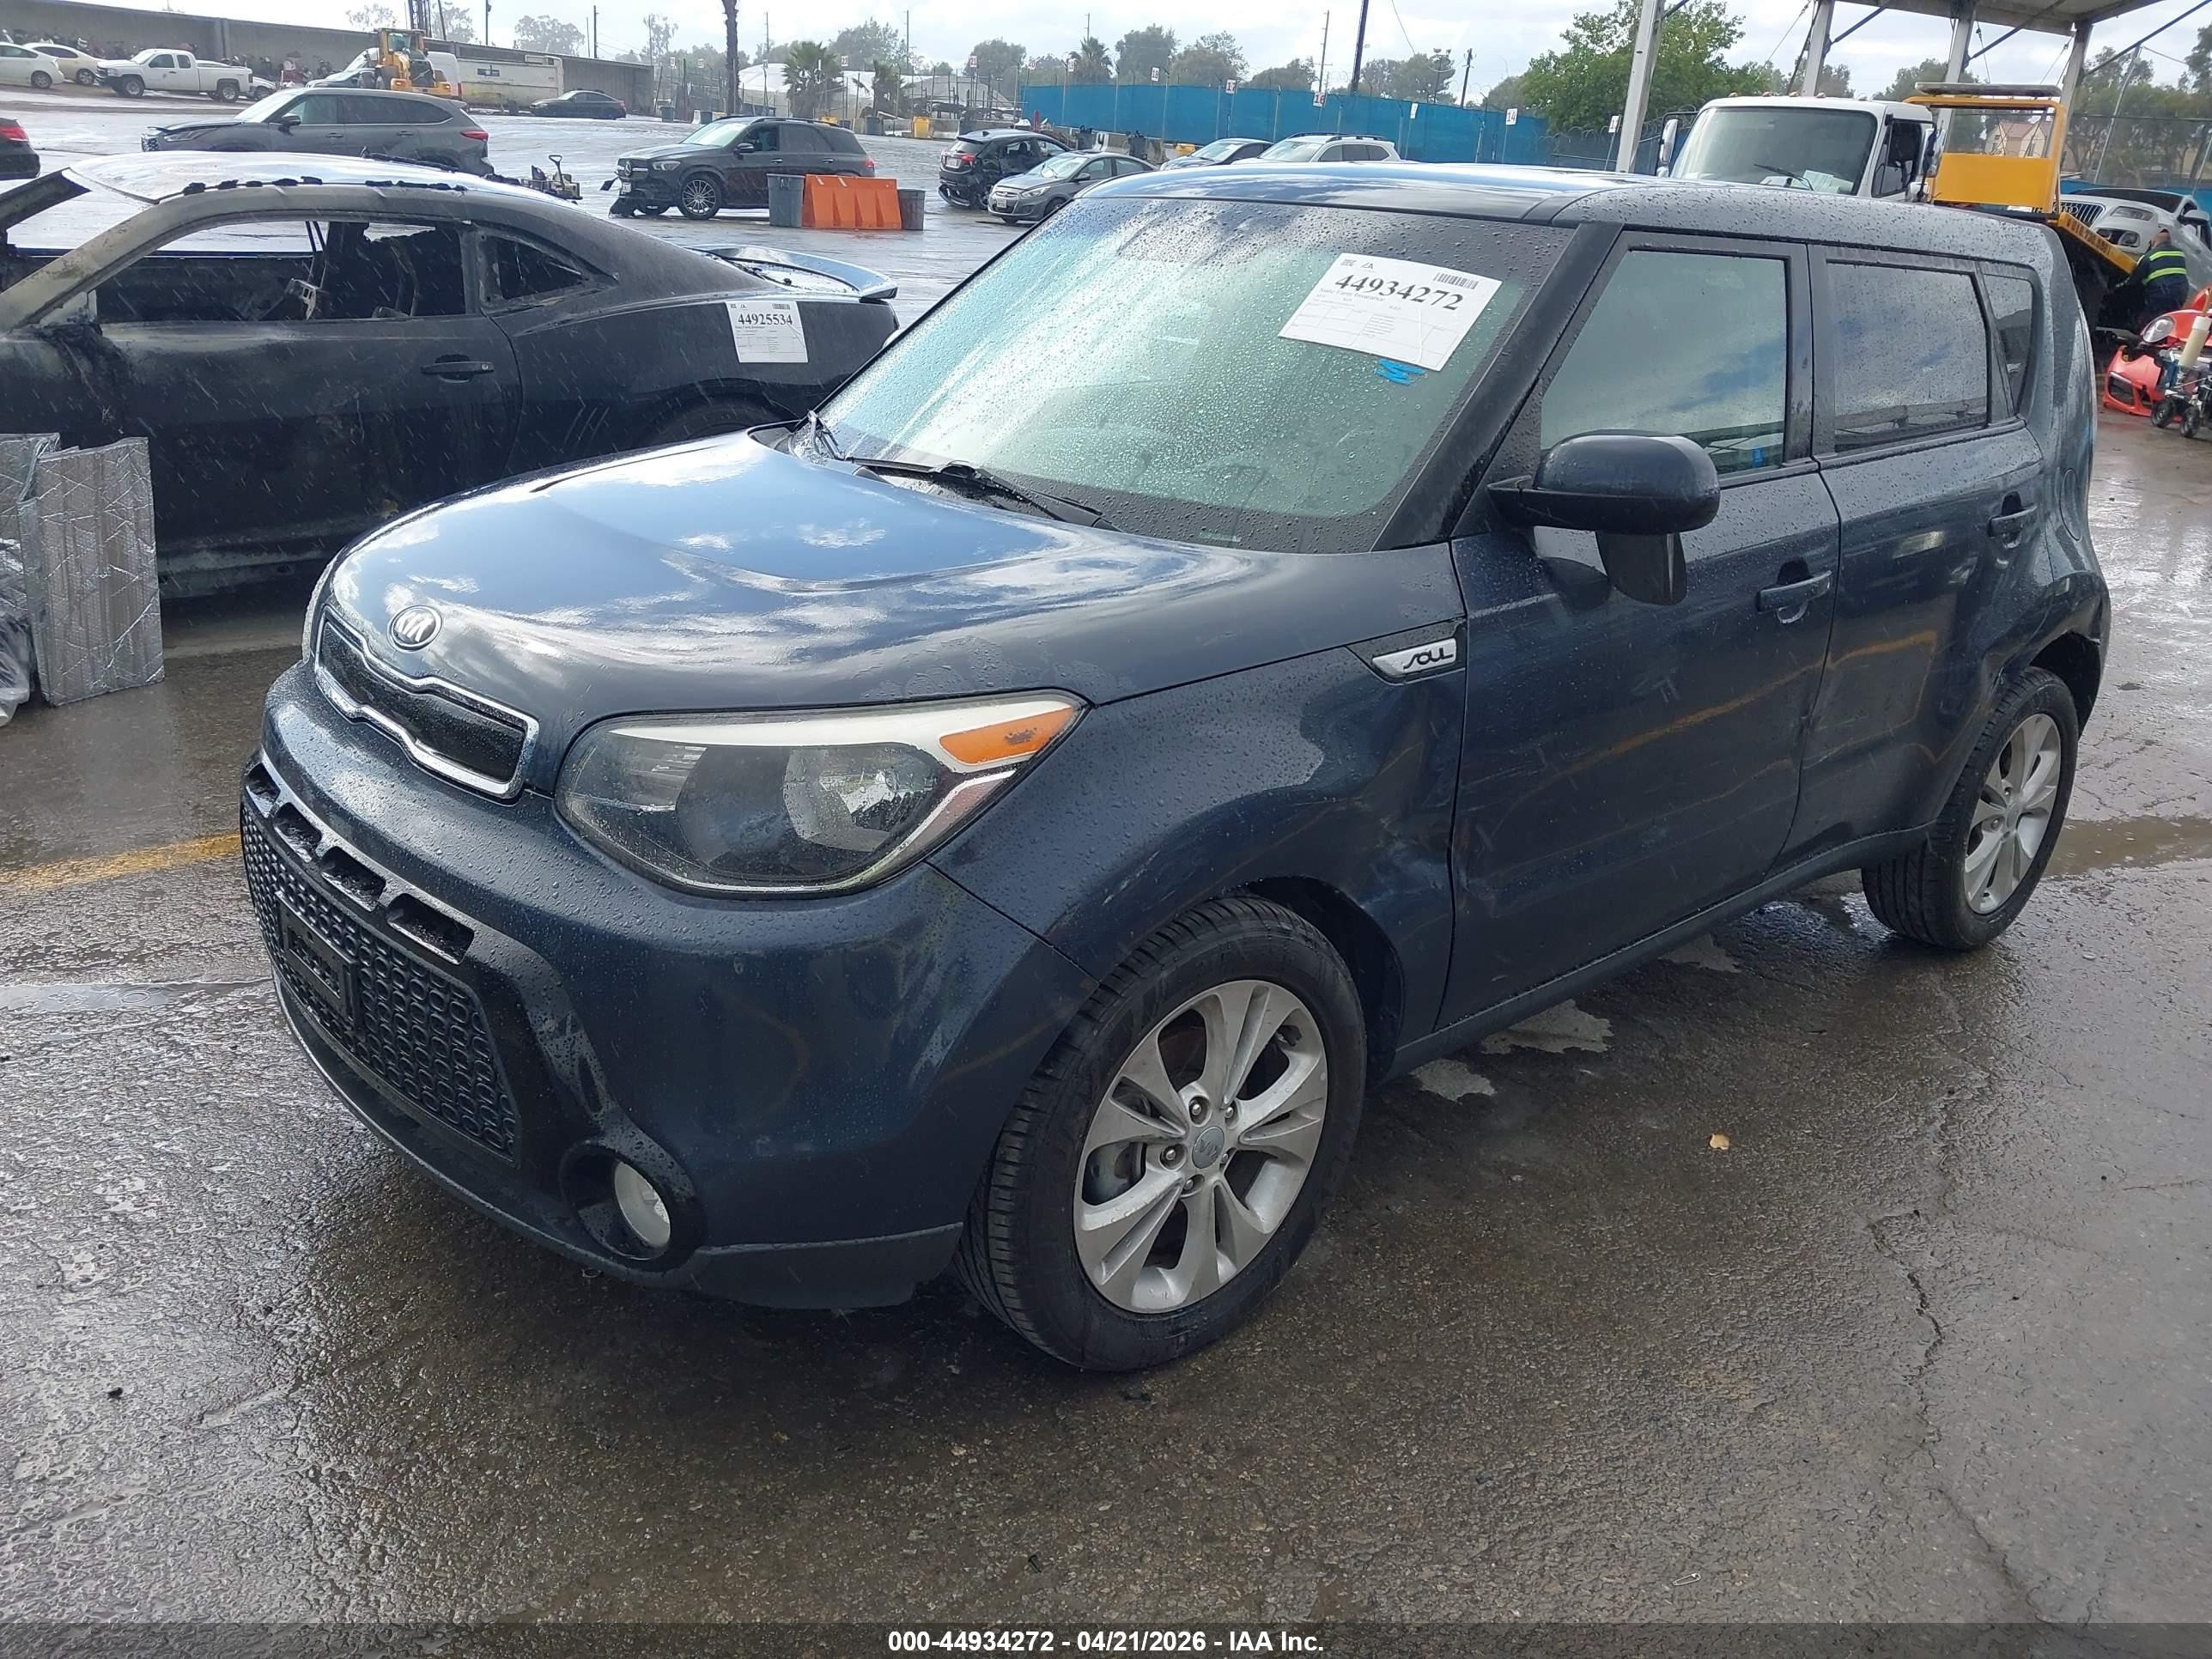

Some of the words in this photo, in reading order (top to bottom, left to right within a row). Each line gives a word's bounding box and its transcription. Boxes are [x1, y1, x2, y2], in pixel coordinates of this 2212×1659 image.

[1315, 94, 1326, 105] 16
[1335, 274, 1463, 310] 44934272
[738, 313, 793, 325] 44925534
